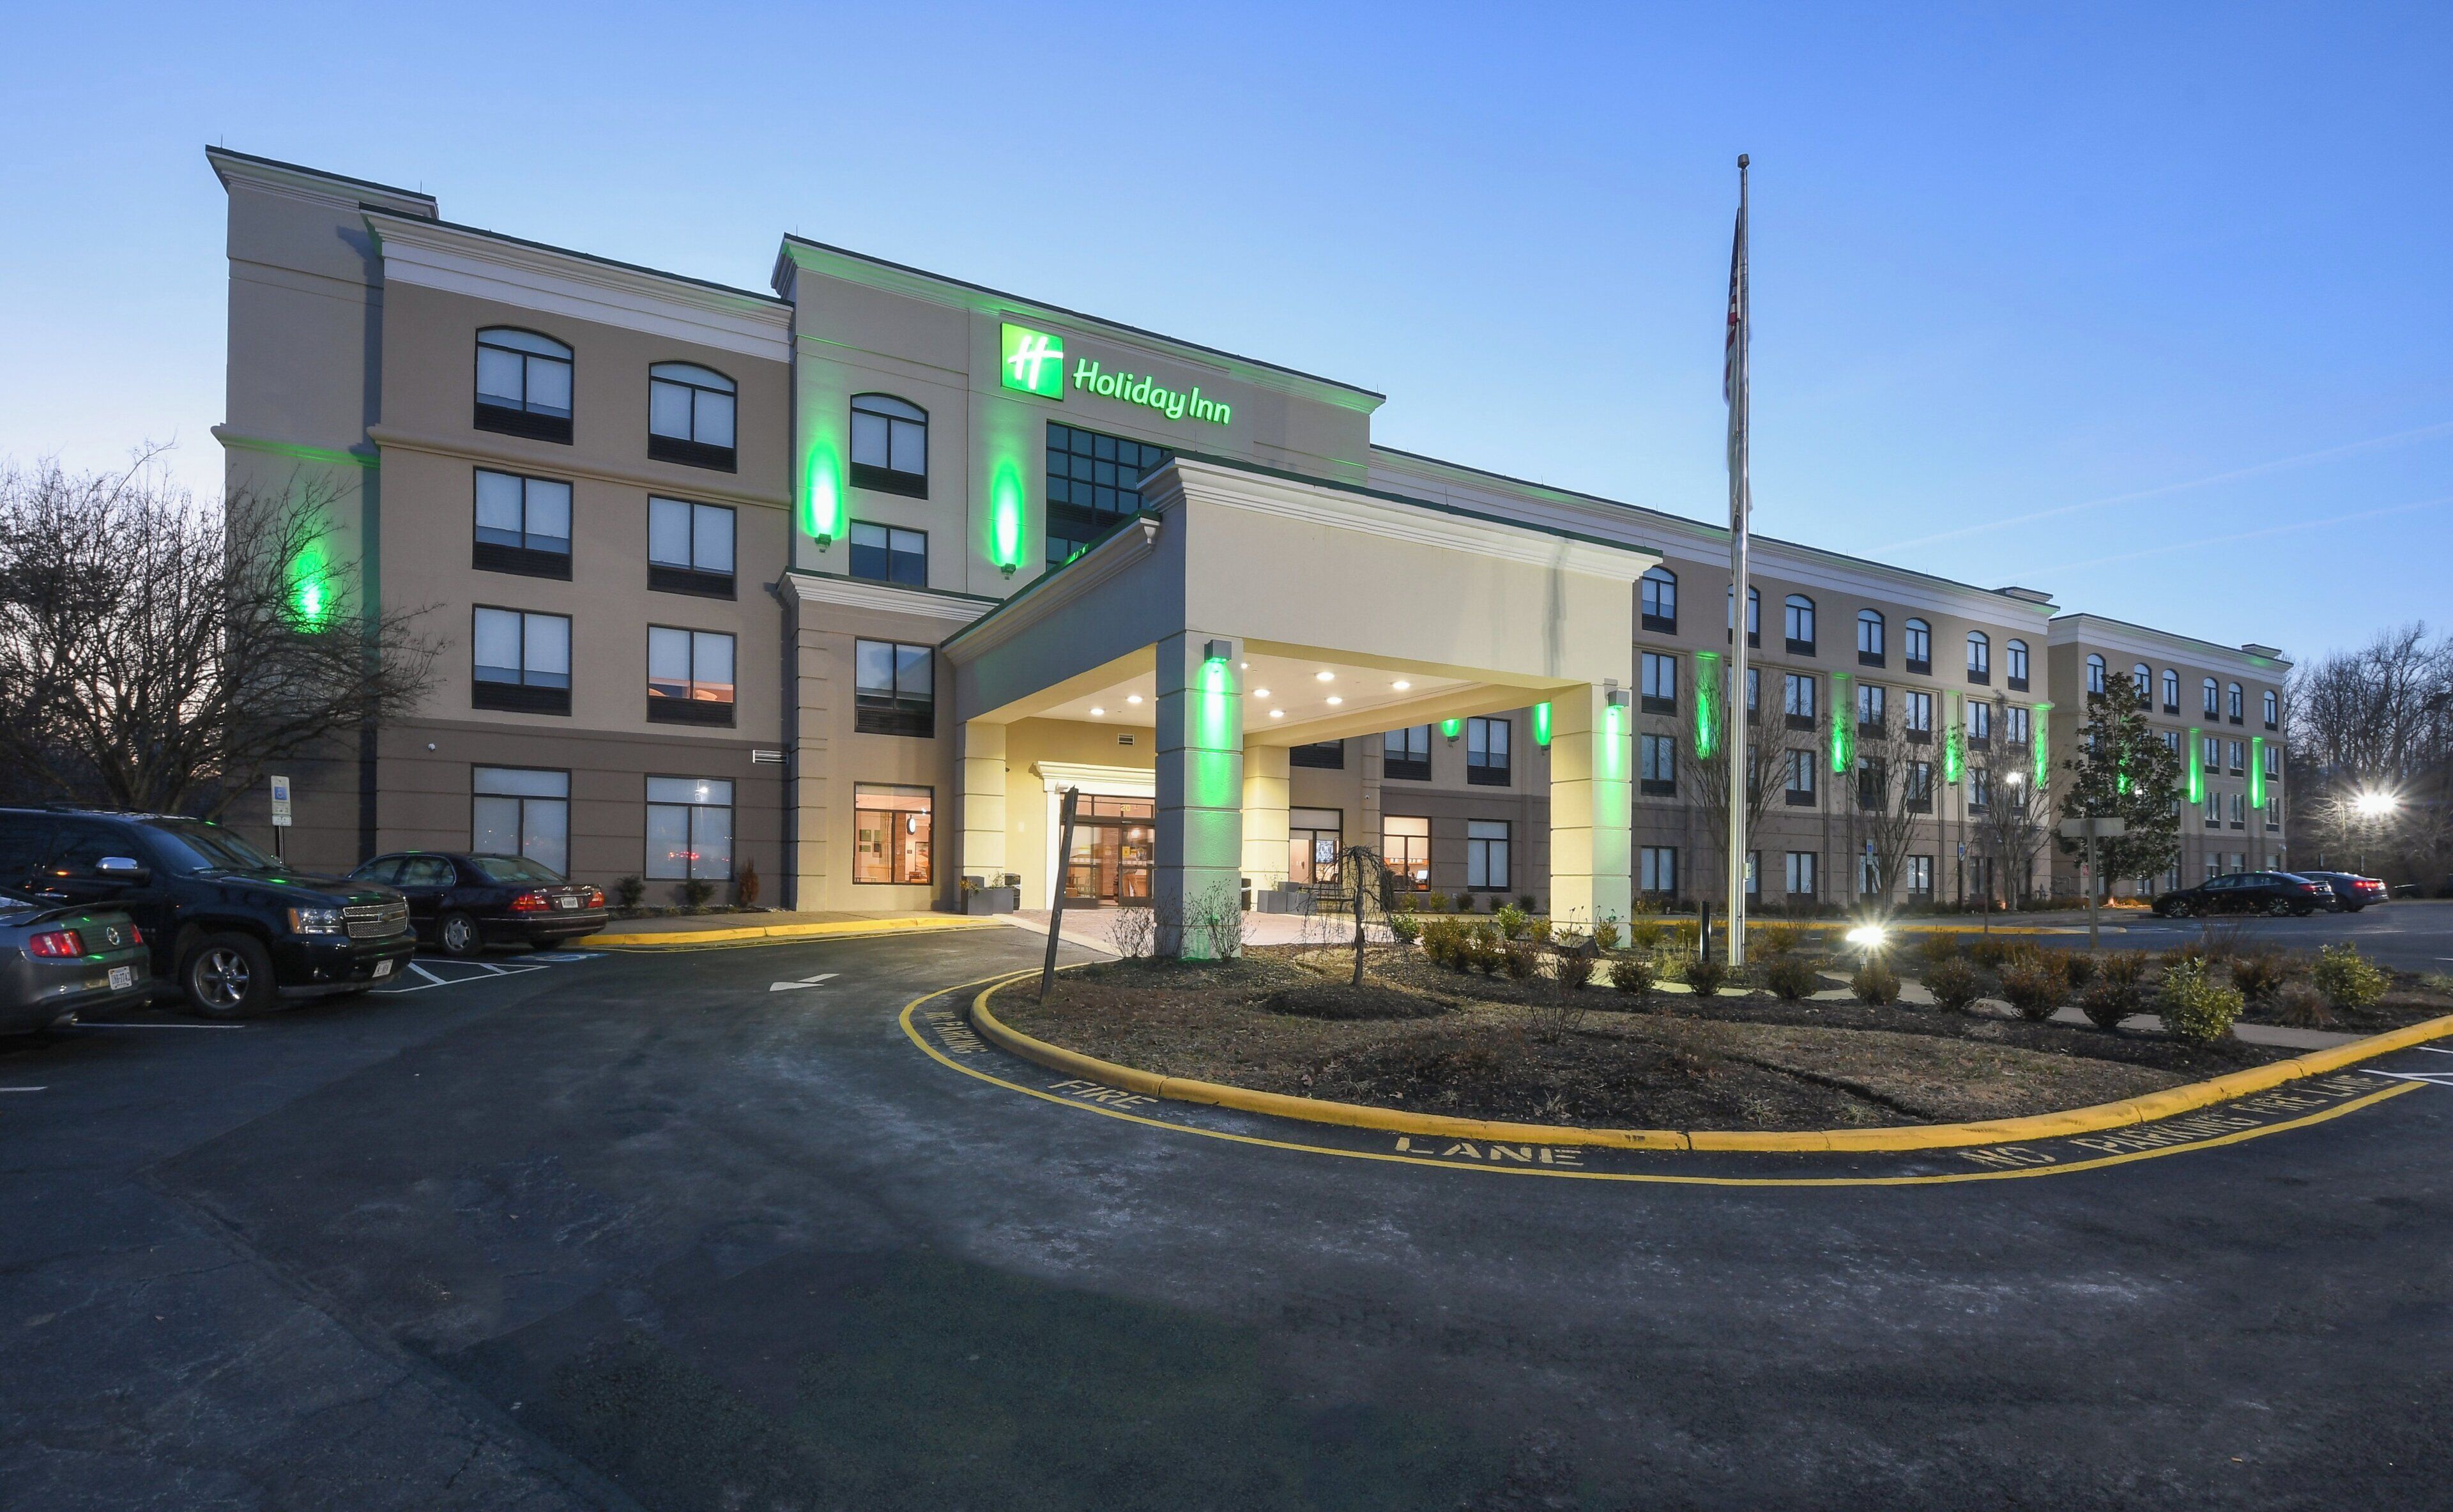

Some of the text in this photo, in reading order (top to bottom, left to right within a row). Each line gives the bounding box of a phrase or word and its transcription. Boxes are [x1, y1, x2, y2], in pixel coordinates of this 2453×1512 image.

[1072, 358, 1231, 425] Holiday Inn
[931, 1021, 988, 1054] PARKING
[1047, 1080, 1584, 1166] FIRE LANE
[1957, 1075, 2397, 1169] NO PARKING FIRE LANE
